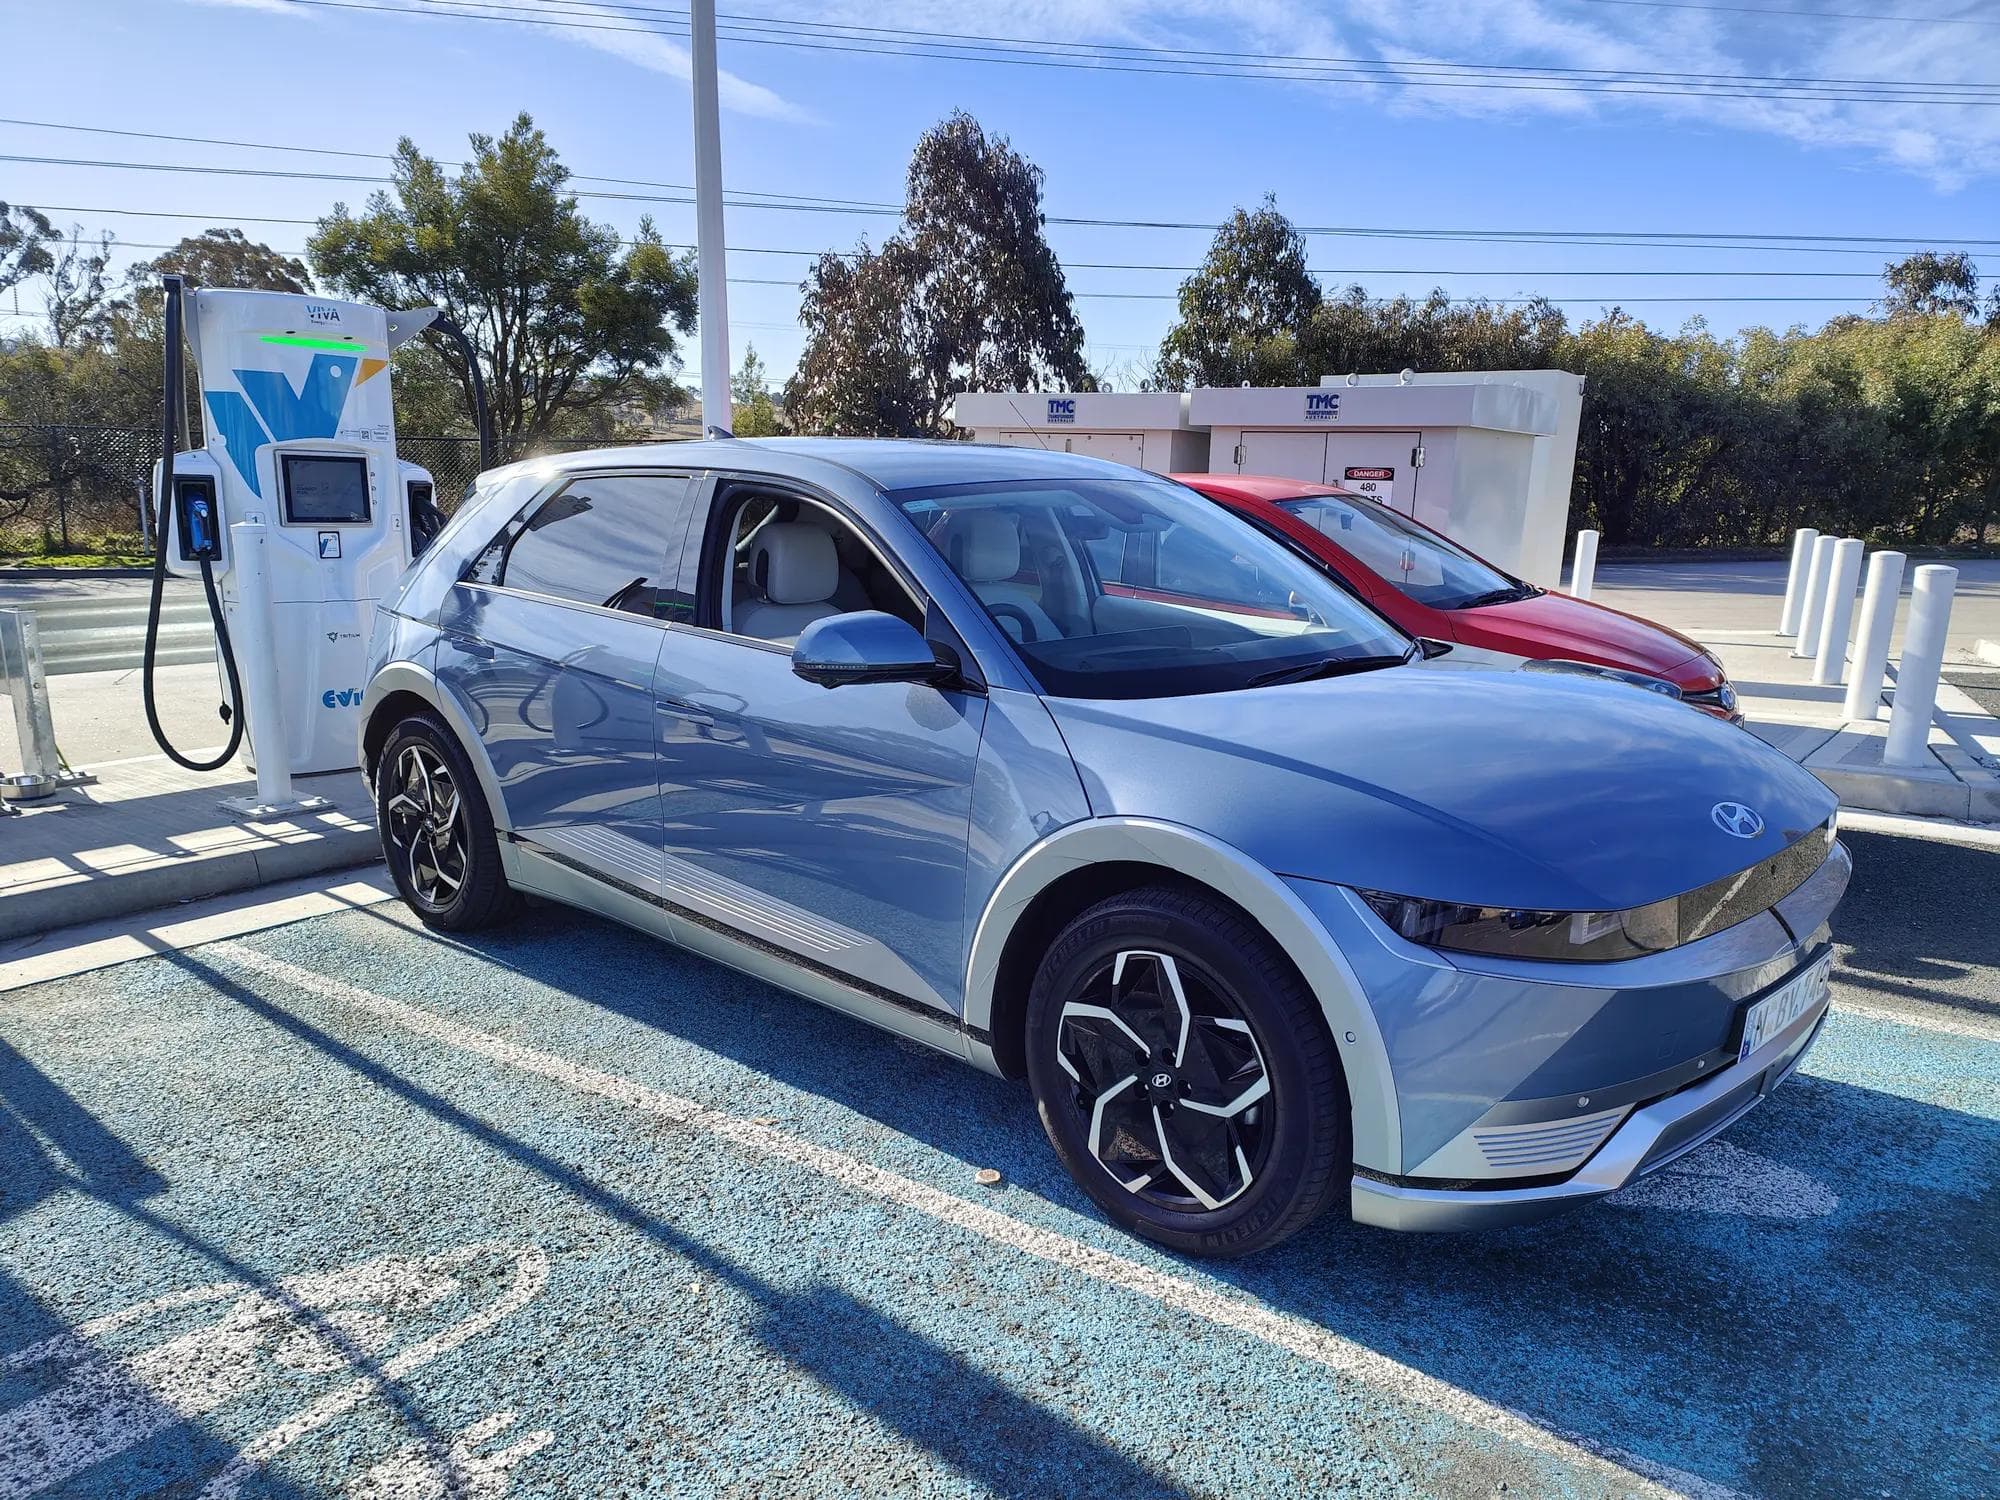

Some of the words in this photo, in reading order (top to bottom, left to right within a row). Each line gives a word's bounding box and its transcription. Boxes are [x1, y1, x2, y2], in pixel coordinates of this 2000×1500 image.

[306, 304, 341, 322] VIVA
[1048, 400, 1075, 413] TMC
[1307, 394, 1340, 409] TMC
[1353, 470, 1385, 478] DANGER
[1360, 482, 1377, 492] 480
